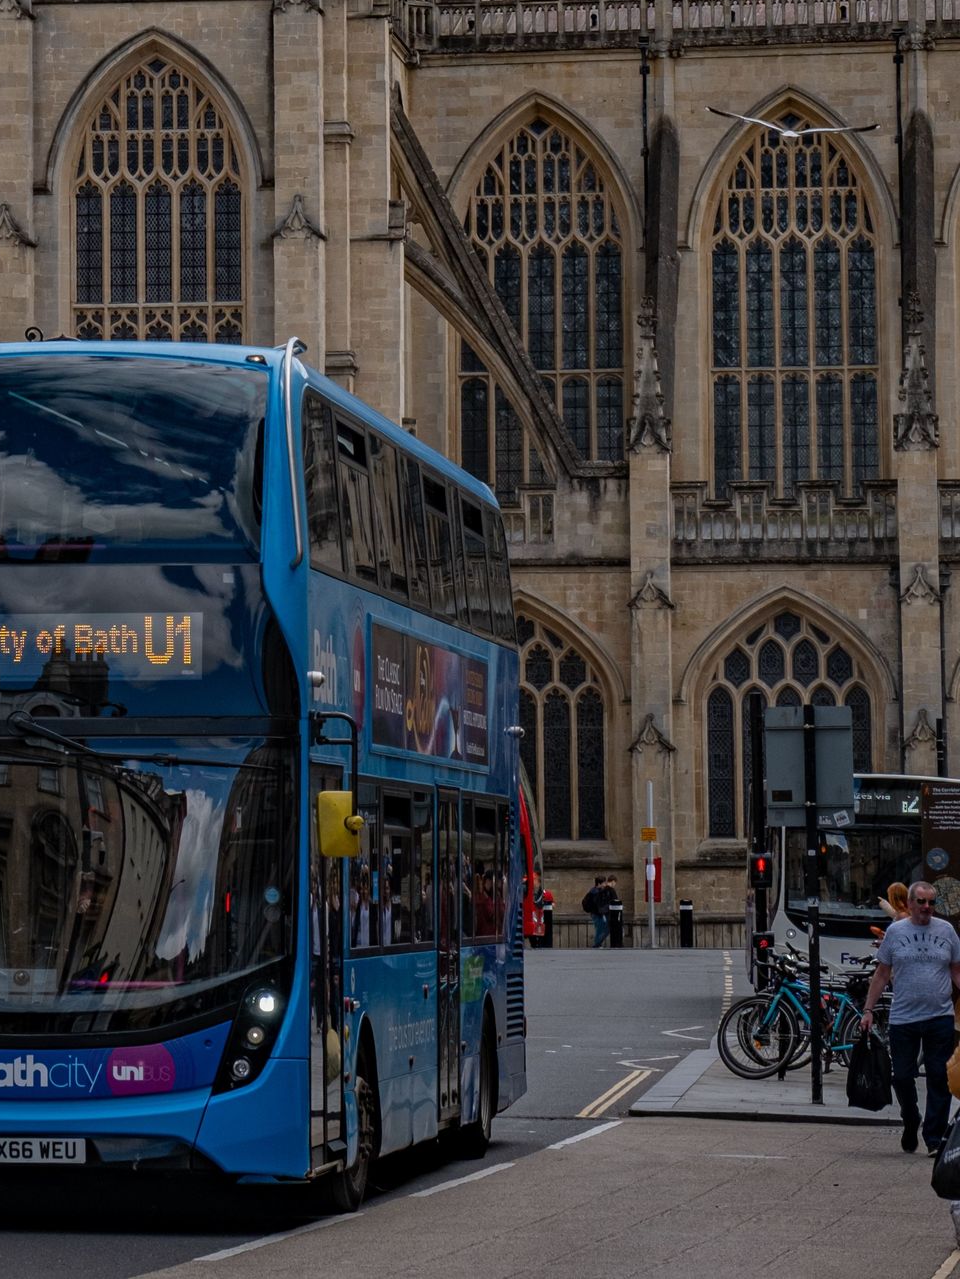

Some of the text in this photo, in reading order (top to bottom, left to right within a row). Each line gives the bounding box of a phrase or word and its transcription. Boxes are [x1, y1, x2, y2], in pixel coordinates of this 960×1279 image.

[36, 624, 66, 654] of
[74, 624, 139, 654] Bath
[144, 615, 192, 665] U1
[40, 1141, 77, 1159] WEU
